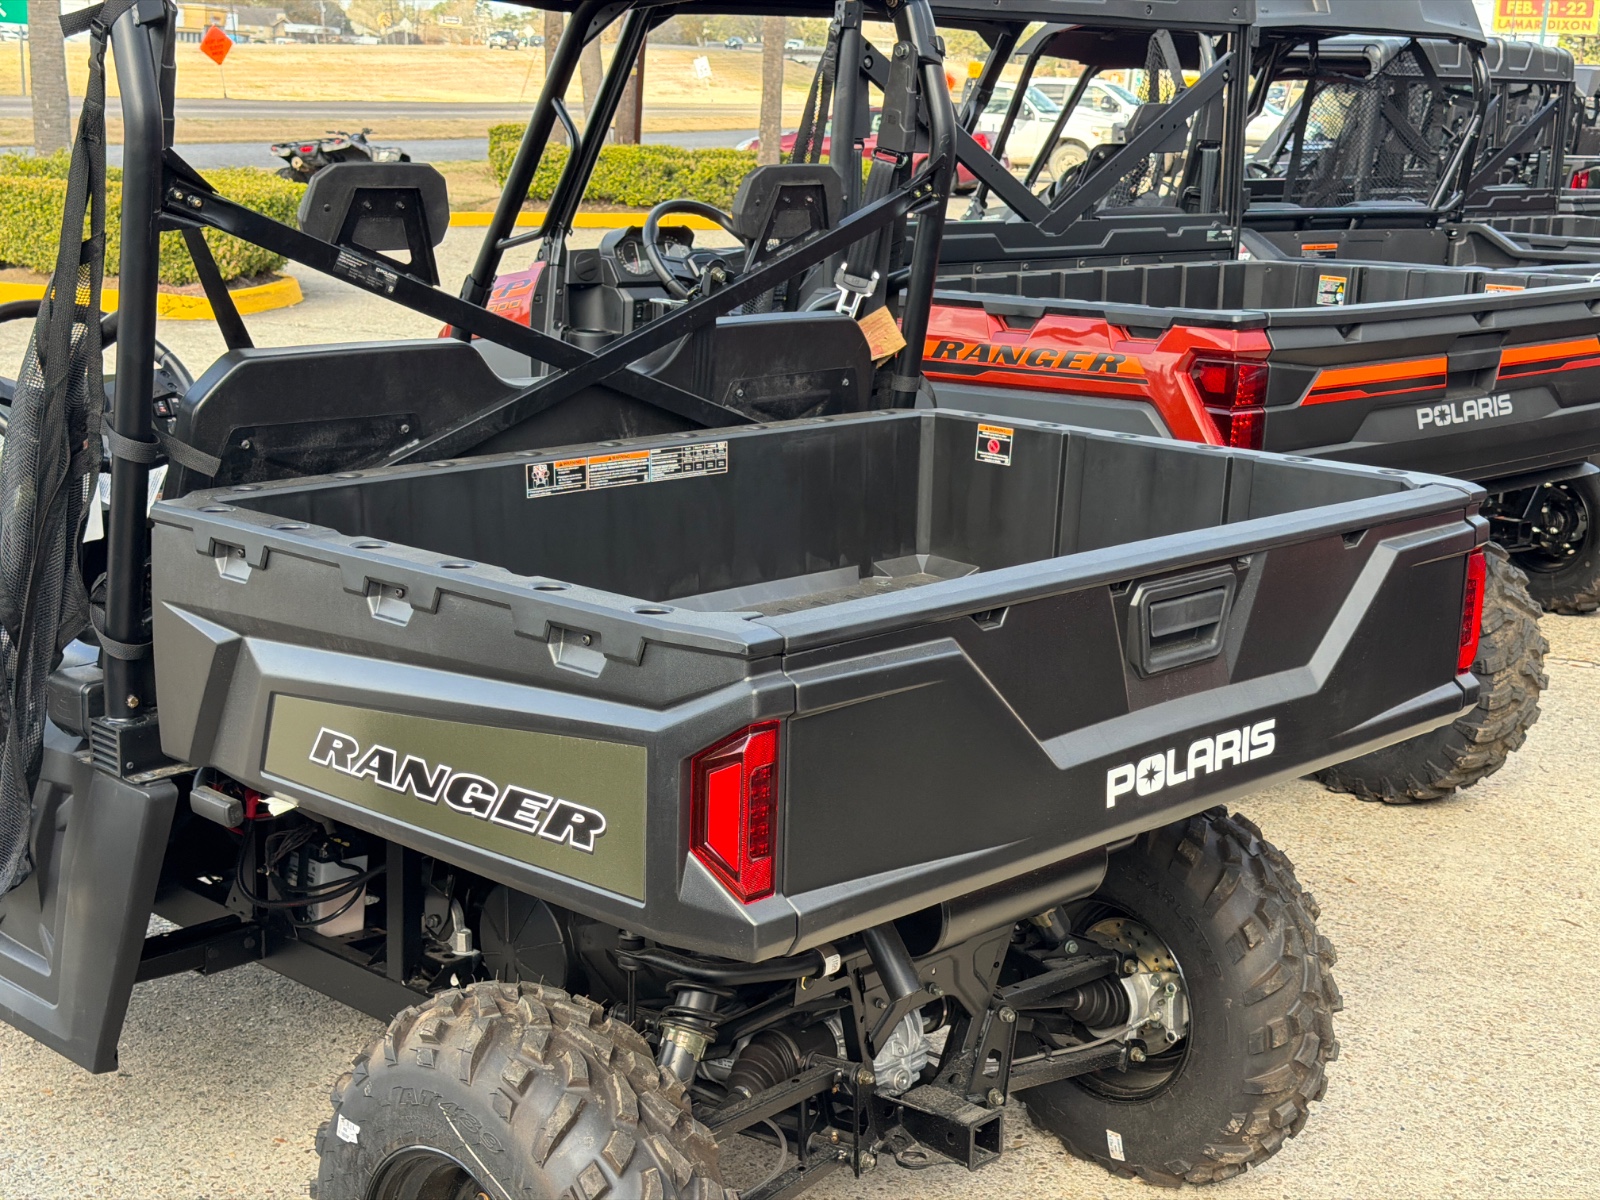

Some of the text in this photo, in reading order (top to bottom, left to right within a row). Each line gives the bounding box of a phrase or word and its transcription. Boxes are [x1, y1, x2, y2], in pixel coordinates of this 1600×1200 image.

[1498, 19, 1591, 31] LAMAR DIXON
[1506, 1, 1538, 15] FEB.
[931, 340, 1126, 374] RANGER
[1416, 394, 1513, 430] POLARIS
[1106, 718, 1276, 809] POLARIS
[309, 727, 607, 853] RANGER
